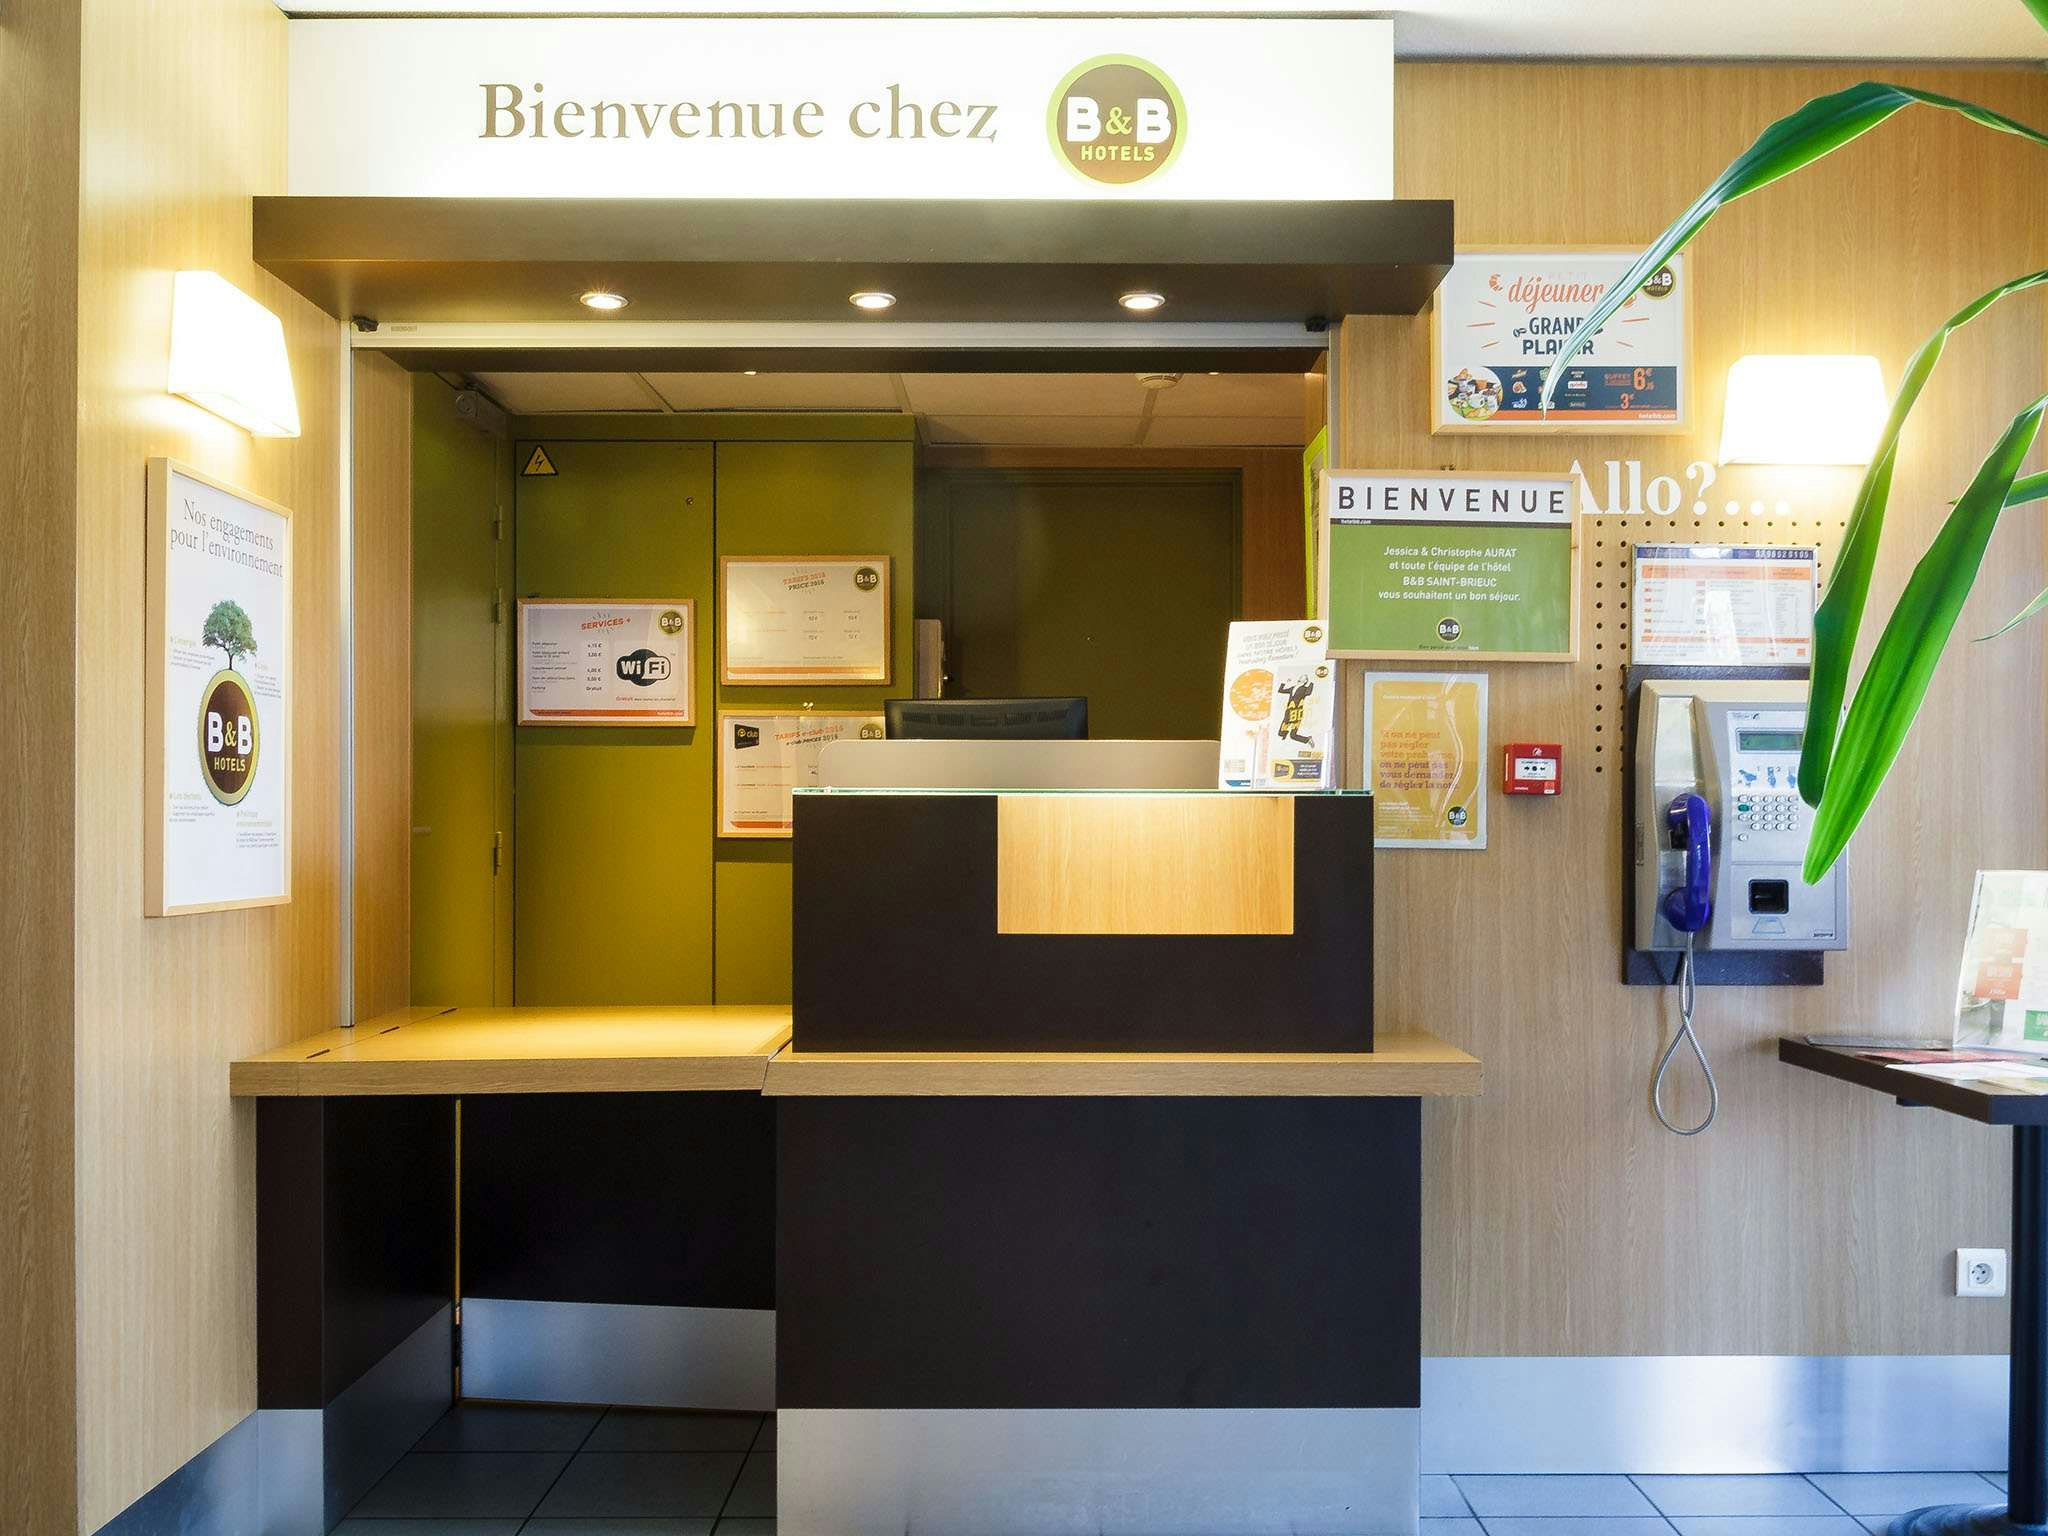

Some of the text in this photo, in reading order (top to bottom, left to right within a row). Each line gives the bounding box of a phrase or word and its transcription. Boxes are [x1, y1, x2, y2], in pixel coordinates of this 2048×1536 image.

[478, 82, 997, 142] Bienvenue chez
[1066, 96, 1172, 144] B&B
[1080, 144, 1156, 162] HOTELS
[1508, 276, 1605, 314] déjeuner
[1337, 486, 1565, 514] BIENVENUE
[184, 497, 274, 551] Nos engagements
[170, 529, 284, 578] pour l'environnement
[1383, 546, 1518, 560] Jessica & Christophe AURAT
[1389, 561, 1512, 573] et toute l'équipe de l'hôtel
[1403, 576, 1497, 588] B&B SAINT-BRIEUC
[1378, 591, 1521, 604] vous souhaitent un bon séjour.
[581, 618, 624, 630] SERVICES
[207, 711, 253, 755] B&B
[214, 757, 246, 771] HOTELS
[1408, 761, 1429, 771] peut
[1380, 771, 1402, 779] vous
[1380, 780, 1391, 788] de
